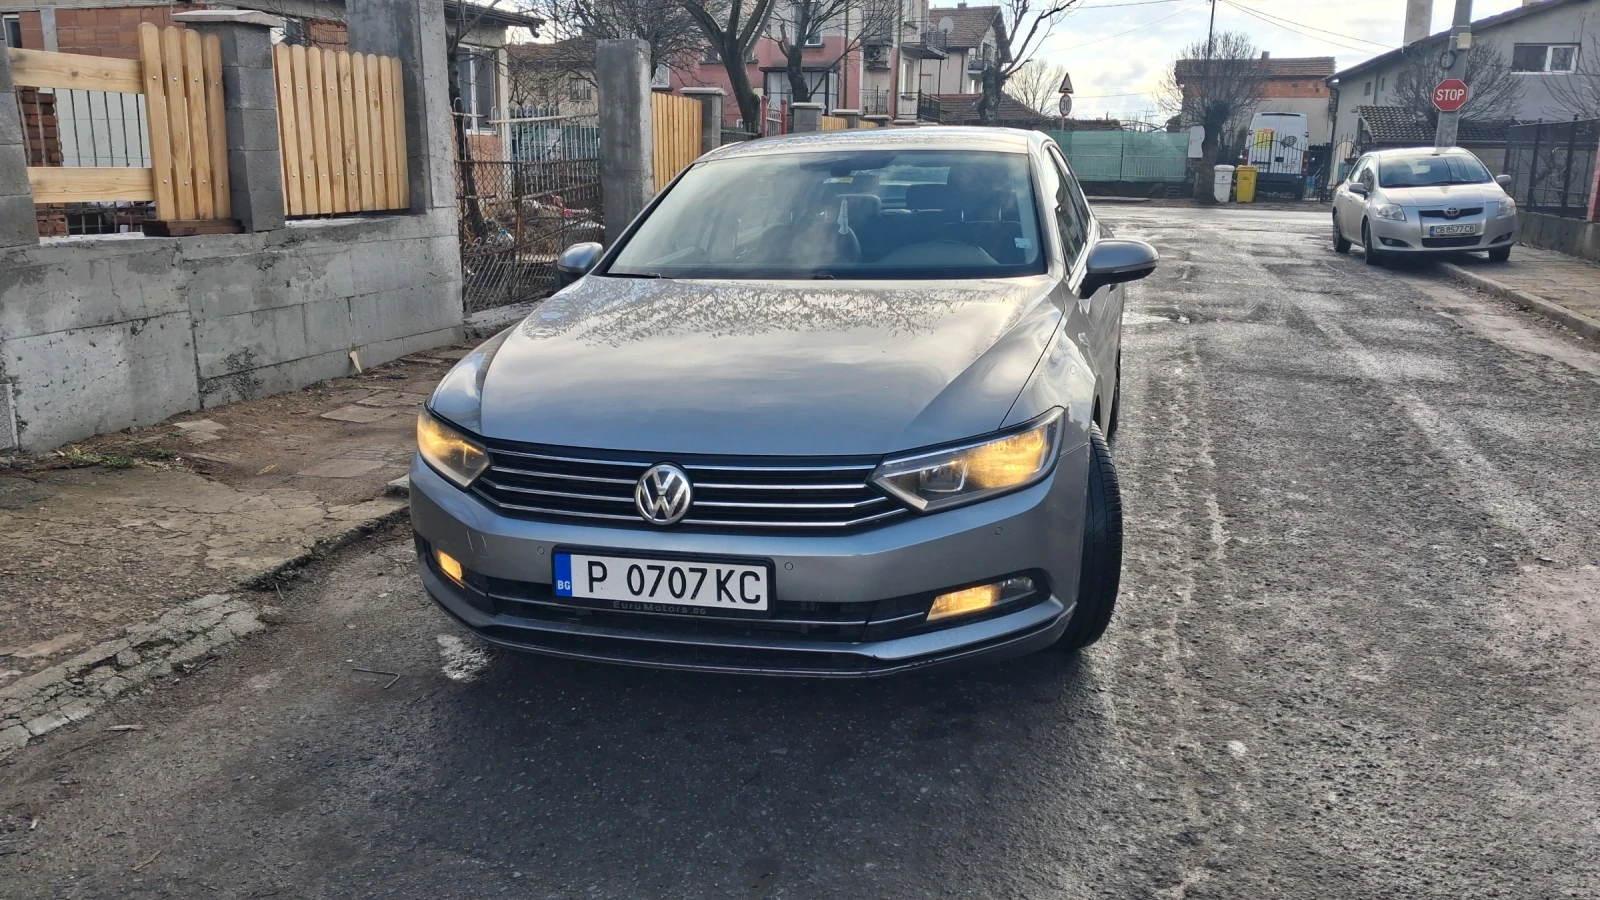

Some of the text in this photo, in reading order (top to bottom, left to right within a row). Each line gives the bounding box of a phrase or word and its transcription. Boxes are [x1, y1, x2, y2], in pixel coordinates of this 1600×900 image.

[1436, 89, 1465, 101] STOP
[1062, 99, 1070, 111] 30
[636, 464, 692, 523] VW
[557, 580, 571, 591] BG
[588, 561, 761, 604] P 0707 KC
